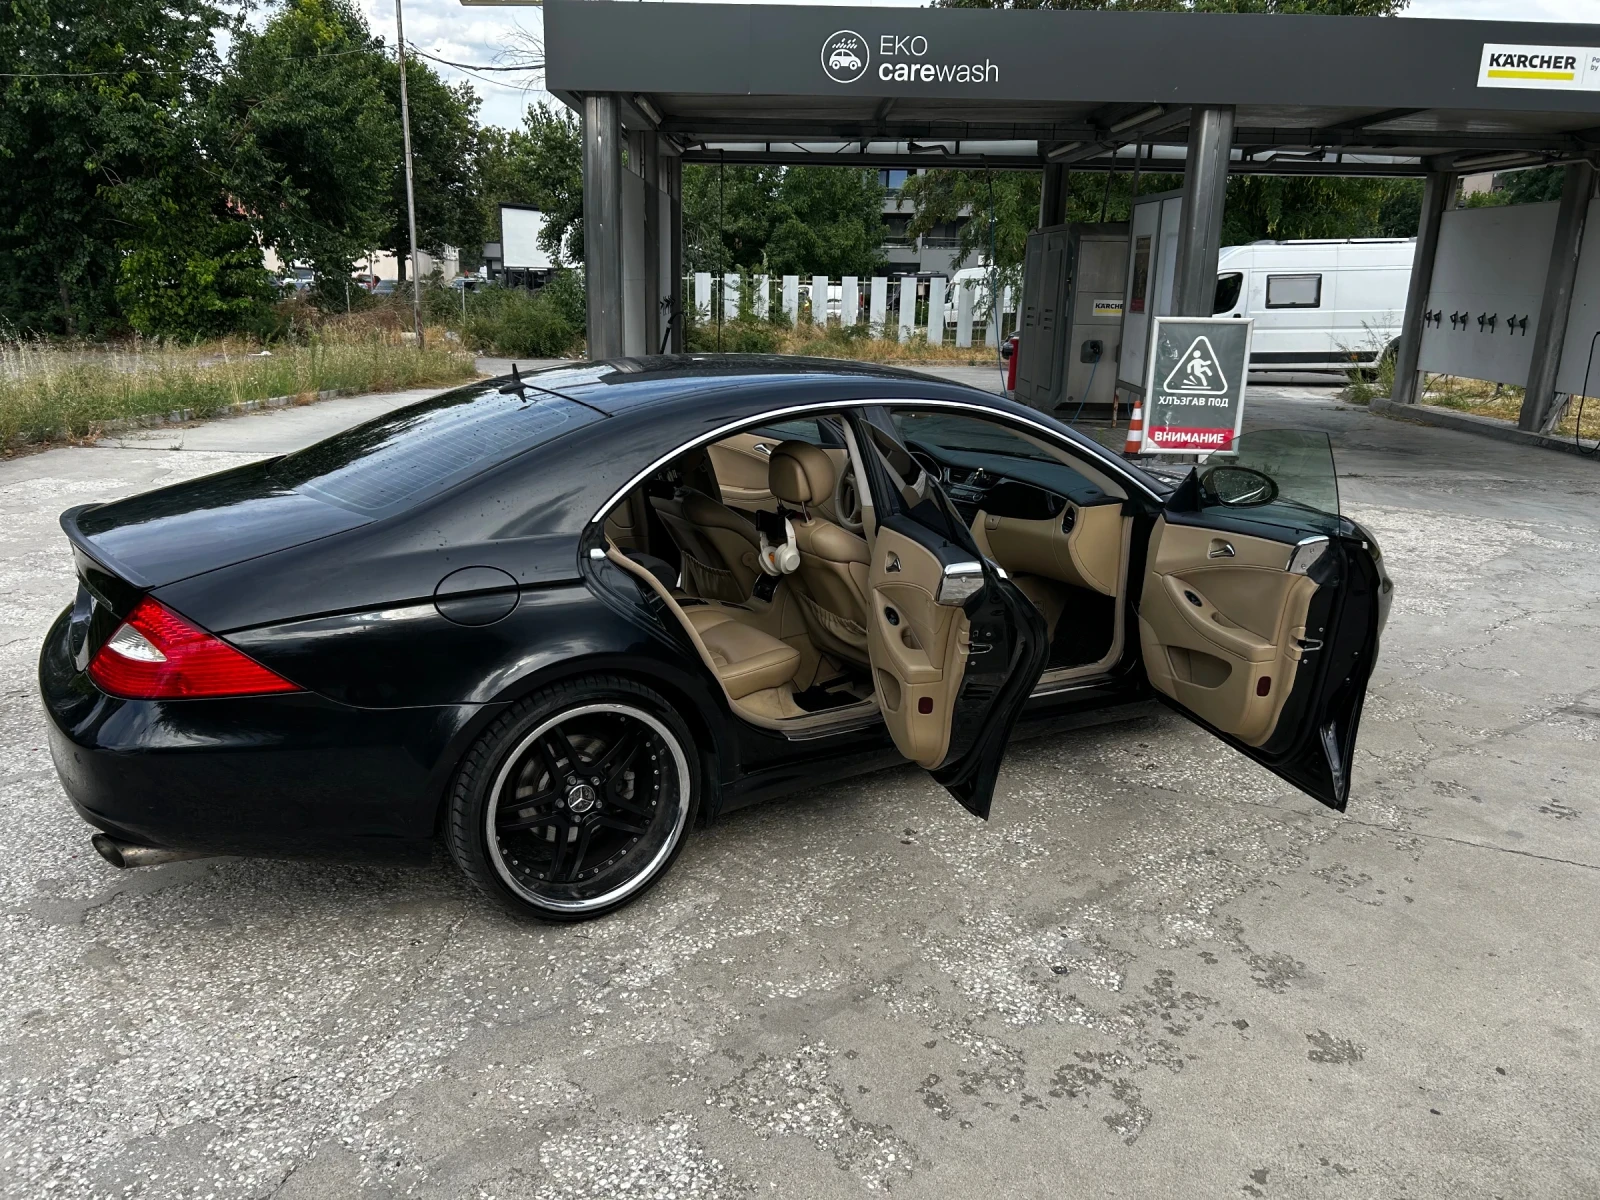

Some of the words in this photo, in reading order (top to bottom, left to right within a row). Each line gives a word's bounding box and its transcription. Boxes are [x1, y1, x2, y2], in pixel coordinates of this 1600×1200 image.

[879, 35, 928, 56] EKO
[1489, 53, 1577, 70] KÄRCHER
[878, 59, 999, 83] carewash
[1158, 396, 1206, 406] ХЛЪЗГАВ
[1208, 397, 1229, 407] ПОД
[1154, 431, 1225, 444] ВНИМАНИЕ
